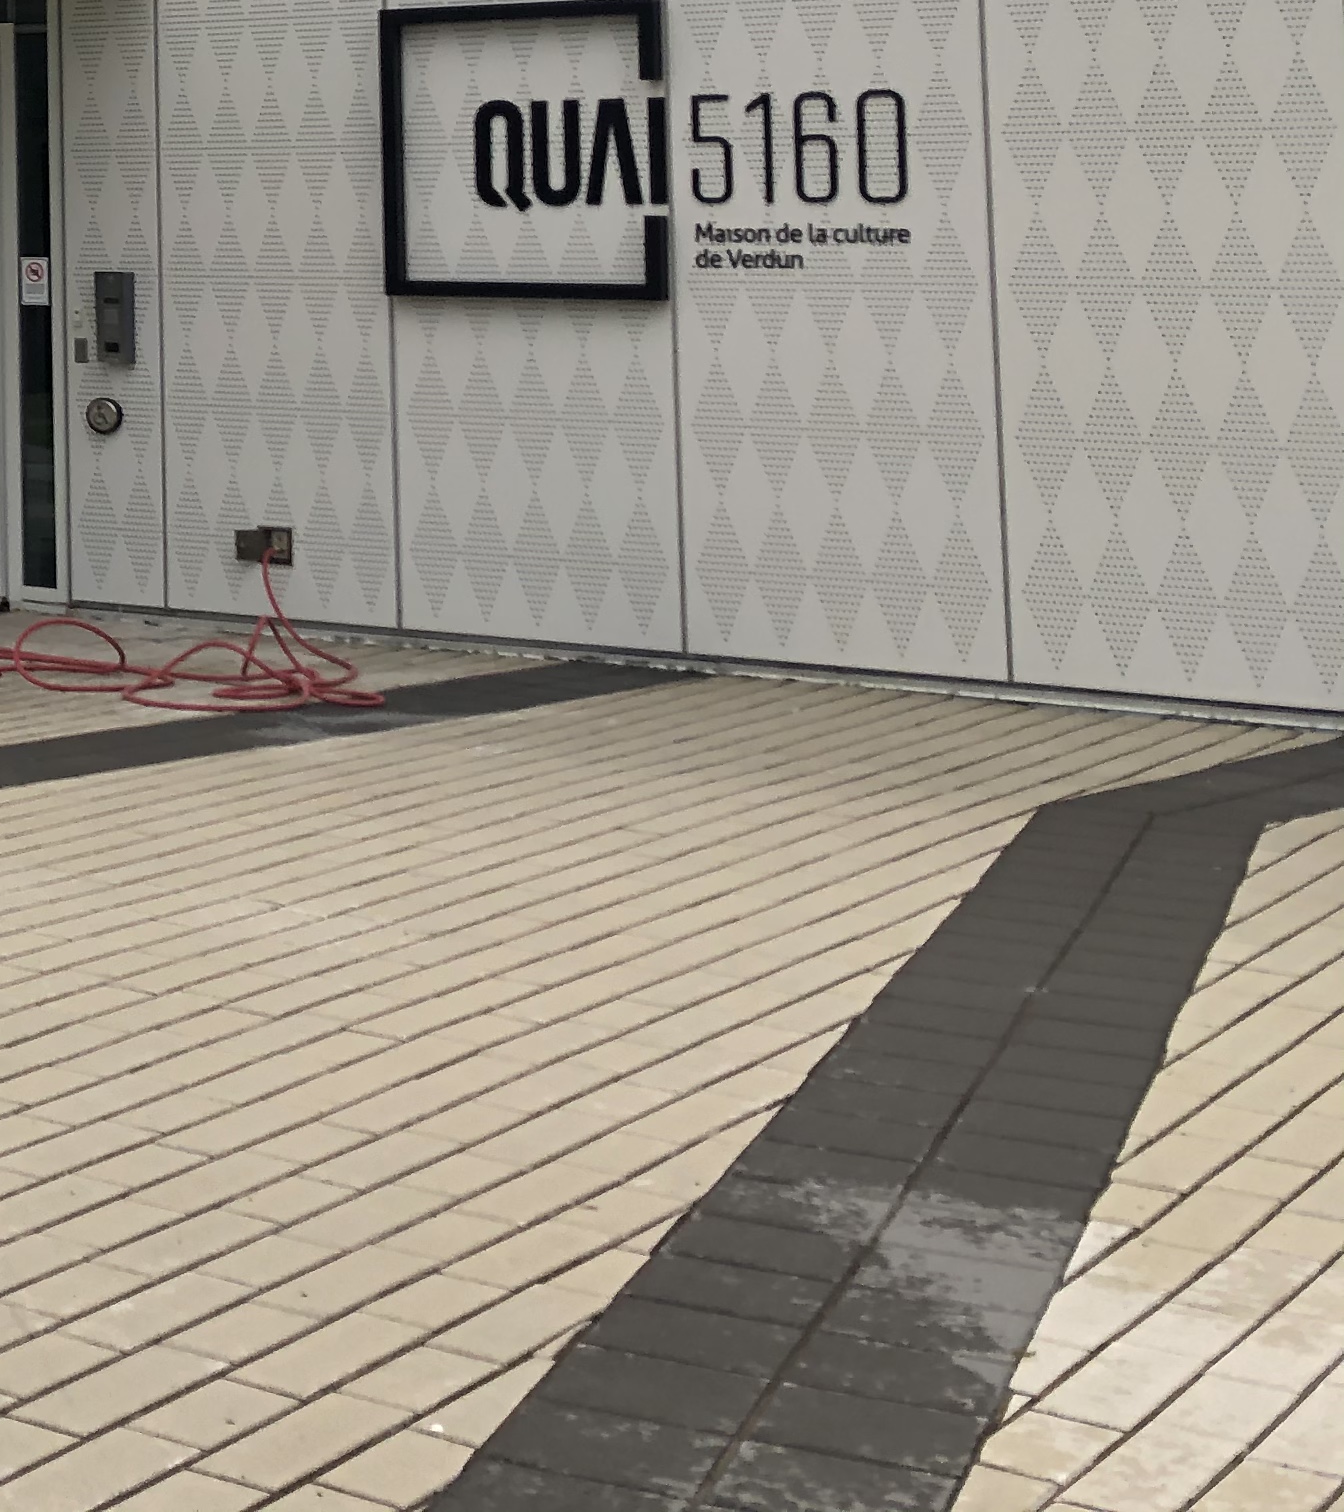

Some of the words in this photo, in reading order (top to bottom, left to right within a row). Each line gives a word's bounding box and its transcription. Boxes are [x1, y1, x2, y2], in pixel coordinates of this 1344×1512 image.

[473, 96, 669, 213] QUAI
[689, 89, 910, 205] 5160
[694, 221, 771, 244] Maison
[775, 223, 803, 244] de
[807, 222, 828, 244] la
[832, 222, 912, 245] culture
[695, 249, 723, 269] de
[726, 248, 805, 270] Verdun
